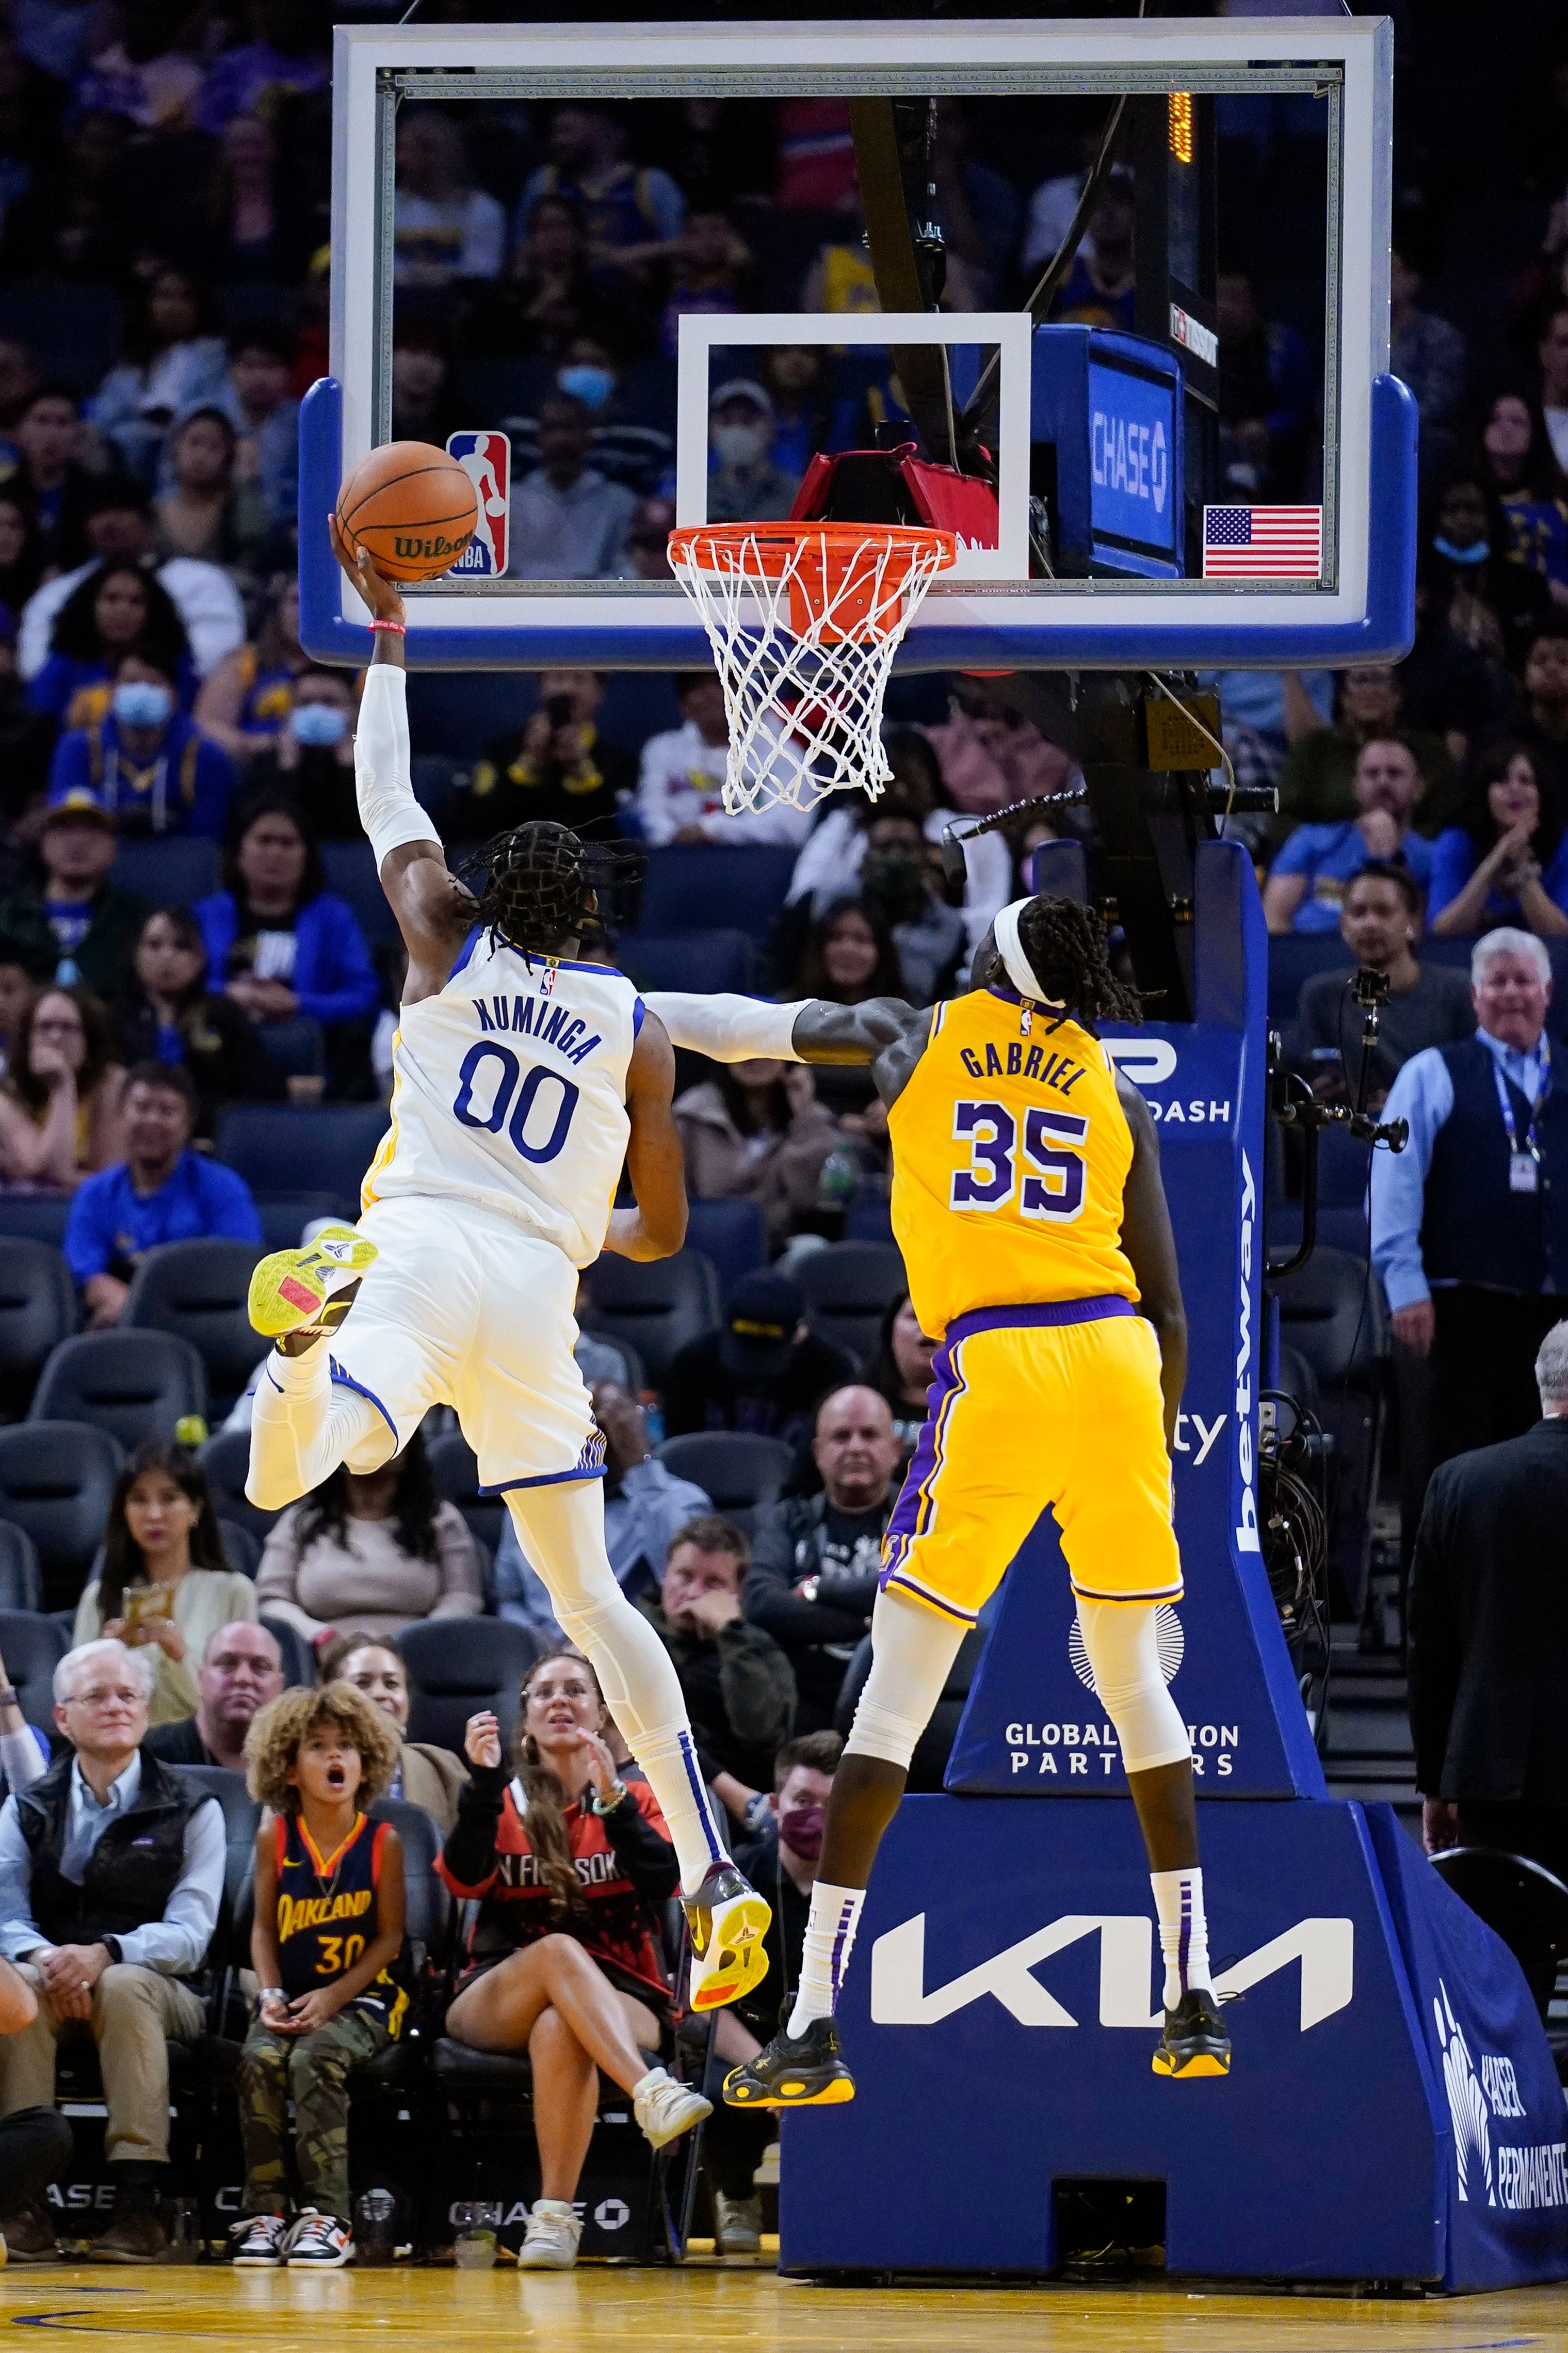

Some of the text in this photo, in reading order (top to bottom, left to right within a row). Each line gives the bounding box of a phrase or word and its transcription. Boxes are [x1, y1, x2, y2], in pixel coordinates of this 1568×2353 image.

[1092, 411, 1150, 499] CHASE
[472, 995, 602, 1066] KUMINGA
[960, 1042, 1087, 1096] GABRIEL
[454, 1040, 579, 1164] 00
[949, 1099, 1091, 1224] 35
[1236, 1147, 1260, 1552] betway
[1005, 1723, 1118, 1746] GLOBAL
[1010, 1751, 1234, 1776] PARTRS
[277, 1890, 373, 1944] OAKLAND
[314, 1934, 366, 1975] 30
[1482, 2054, 1527, 2118] KAISER
[448, 2201, 588, 2226] CHAE
